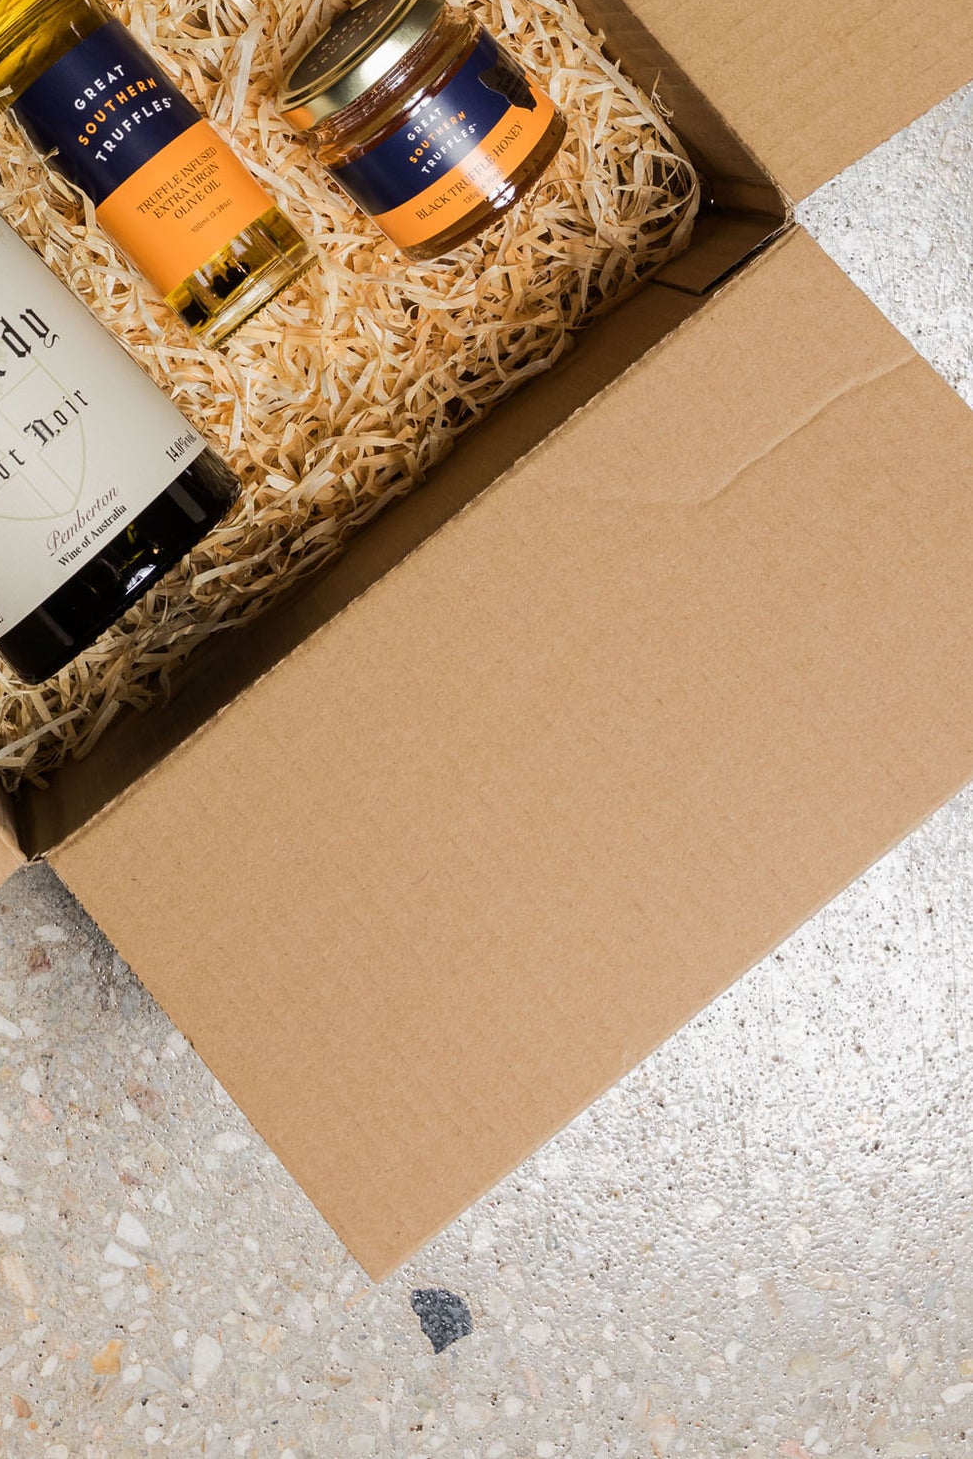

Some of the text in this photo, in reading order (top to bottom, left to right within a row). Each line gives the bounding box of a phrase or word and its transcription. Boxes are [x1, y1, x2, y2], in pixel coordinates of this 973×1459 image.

[74, 64, 127, 111] GREAT
[78, 76, 158, 146] SOUTHERN
[407, 108, 443, 141] GREAT
[409, 111, 467, 164] SOUTHERN
[136, 146, 217, 215] TRUFFLE INFUSED
[153, 161, 220, 220] EXTRA VIRGIN
[174, 179, 222, 221] OLIVE OIL
[415, 120, 524, 221] BLACK TRUFFLE HONEY
[462, 188, 481, 205] 135g
[23, 387, 90, 448] Noir
[45, 485, 119, 558] Pemberton
[58, 503, 128, 568] Wine of Australia
